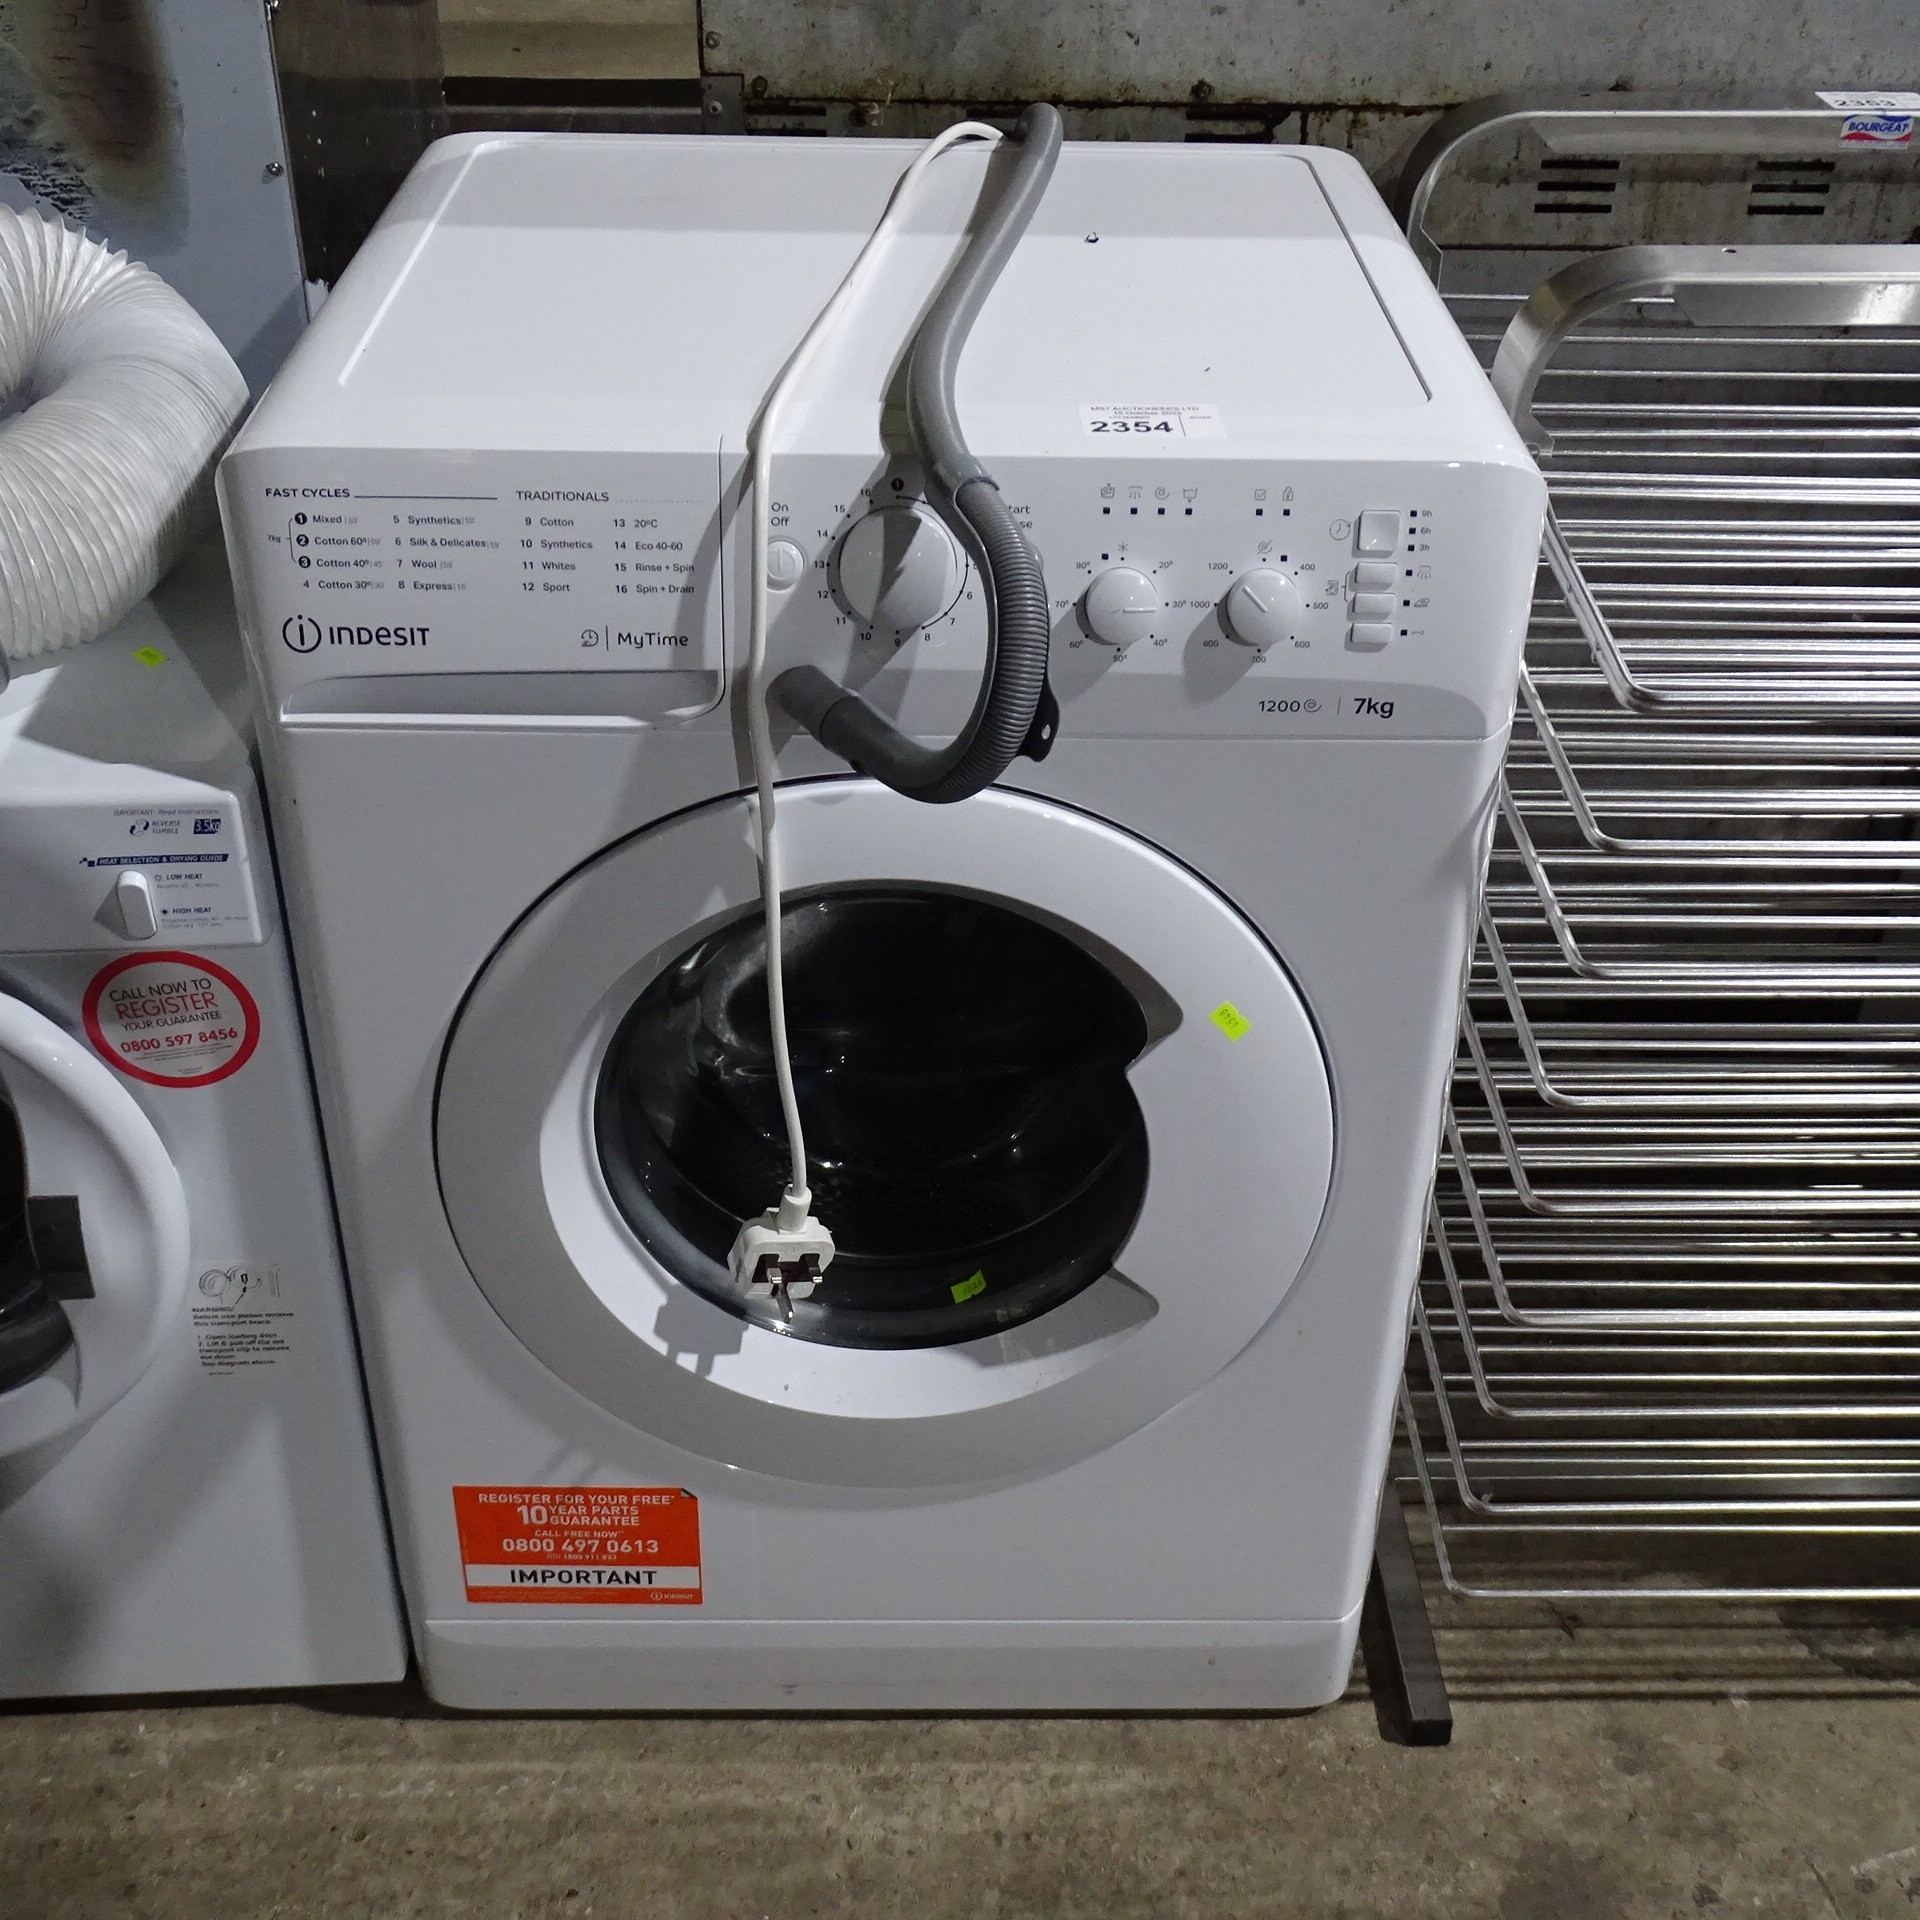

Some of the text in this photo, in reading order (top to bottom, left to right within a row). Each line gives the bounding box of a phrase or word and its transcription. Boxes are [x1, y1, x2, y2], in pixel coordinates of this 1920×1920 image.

[1848, 122, 1909, 132] BOURGEAT
[1090, 420, 1173, 432] 2354
[265, 488, 350, 498] FAST CYCLES
[516, 491, 609, 502] TRADITIONALS
[860, 488, 872, 497] 16
[771, 502, 789, 512] On
[834, 504, 846, 514] 15
[1008, 505, 1031, 515] tart
[1421, 510, 1432, 518] 9h
[313, 515, 342, 524] Mixed
[393, 515, 461, 526] 5 Synthetics
[525, 517, 574, 527] 9 Cotton
[613, 518, 626, 528] 13
[770, 516, 790, 527] Off
[816, 529, 829, 538] 14
[1420, 526, 1431, 535] 6h
[314, 537, 349, 546] Cotton
[395, 537, 486, 547] 6 Silk & Delicates
[520, 539, 593, 550] 10 Synthetics
[614, 541, 683, 551] 14 Eco 40-60
[1419, 543, 1430, 552] 3h
[316, 559, 351, 568] Cotton
[397, 559, 437, 569] 7 Wool
[522, 561, 576, 571] 11 Whites
[614, 563, 627, 572] 15
[635, 563, 662, 572] Rinse
[672, 563, 695, 574] Spin
[813, 560, 826, 569] 13
[1207, 562, 1228, 570] 1200
[1299, 563, 1316, 571] 400
[303, 580, 310, 588] 4
[318, 580, 353, 589] Cotton
[398, 580, 453, 592] 8 Express
[521, 582, 571, 593] 12 Sport
[615, 585, 628, 594] 16
[635, 585, 658, 595] Spin
[668, 584, 695, 594] Drain
[817, 591, 829, 599] 12
[966, 591, 973, 600] 6
[1189, 600, 1211, 609] 1000
[1313, 601, 1329, 610] 500
[835, 617, 847, 626] 11
[949, 617, 956, 626] 7
[329, 626, 430, 646] INDESIT
[617, 632, 689, 649] MyTime
[860, 632, 872, 641] 10
[924, 633, 931, 642] 8
[893, 638, 901, 647] 9
[1294, 640, 1311, 649] 600
[1251, 655, 1267, 664] 700
[1258, 700, 1301, 713] 1200
[1353, 697, 1394, 719] 7kg
[119, 856, 160, 865] SELECTION
[169, 855, 199, 863] DRYING
[193, 906, 212, 914] HEAT
[109, 977, 212, 1003] CALL NOW TO
[114, 991, 220, 1021] REGISTER
[121, 1010, 222, 1032] YOUR GUARANTEE
[120, 1038, 161, 1053] 0800
[165, 1033, 193, 1047] 597
[198, 1027, 238, 1044] 8456
[478, 1493, 551, 1504] REGISTER
[555, 1494, 585, 1505] FOR
[588, 1494, 630, 1505] YOUR
[516, 1505, 639, 1525] 10 YEAR PARTS
[549, 1515, 640, 1526] GUARANTEE
[534, 1529, 591, 1538] CALL FREE
[502, 1538, 659, 1554] 0800 497 0613
[510, 1569, 658, 1585] IMPORTANT
